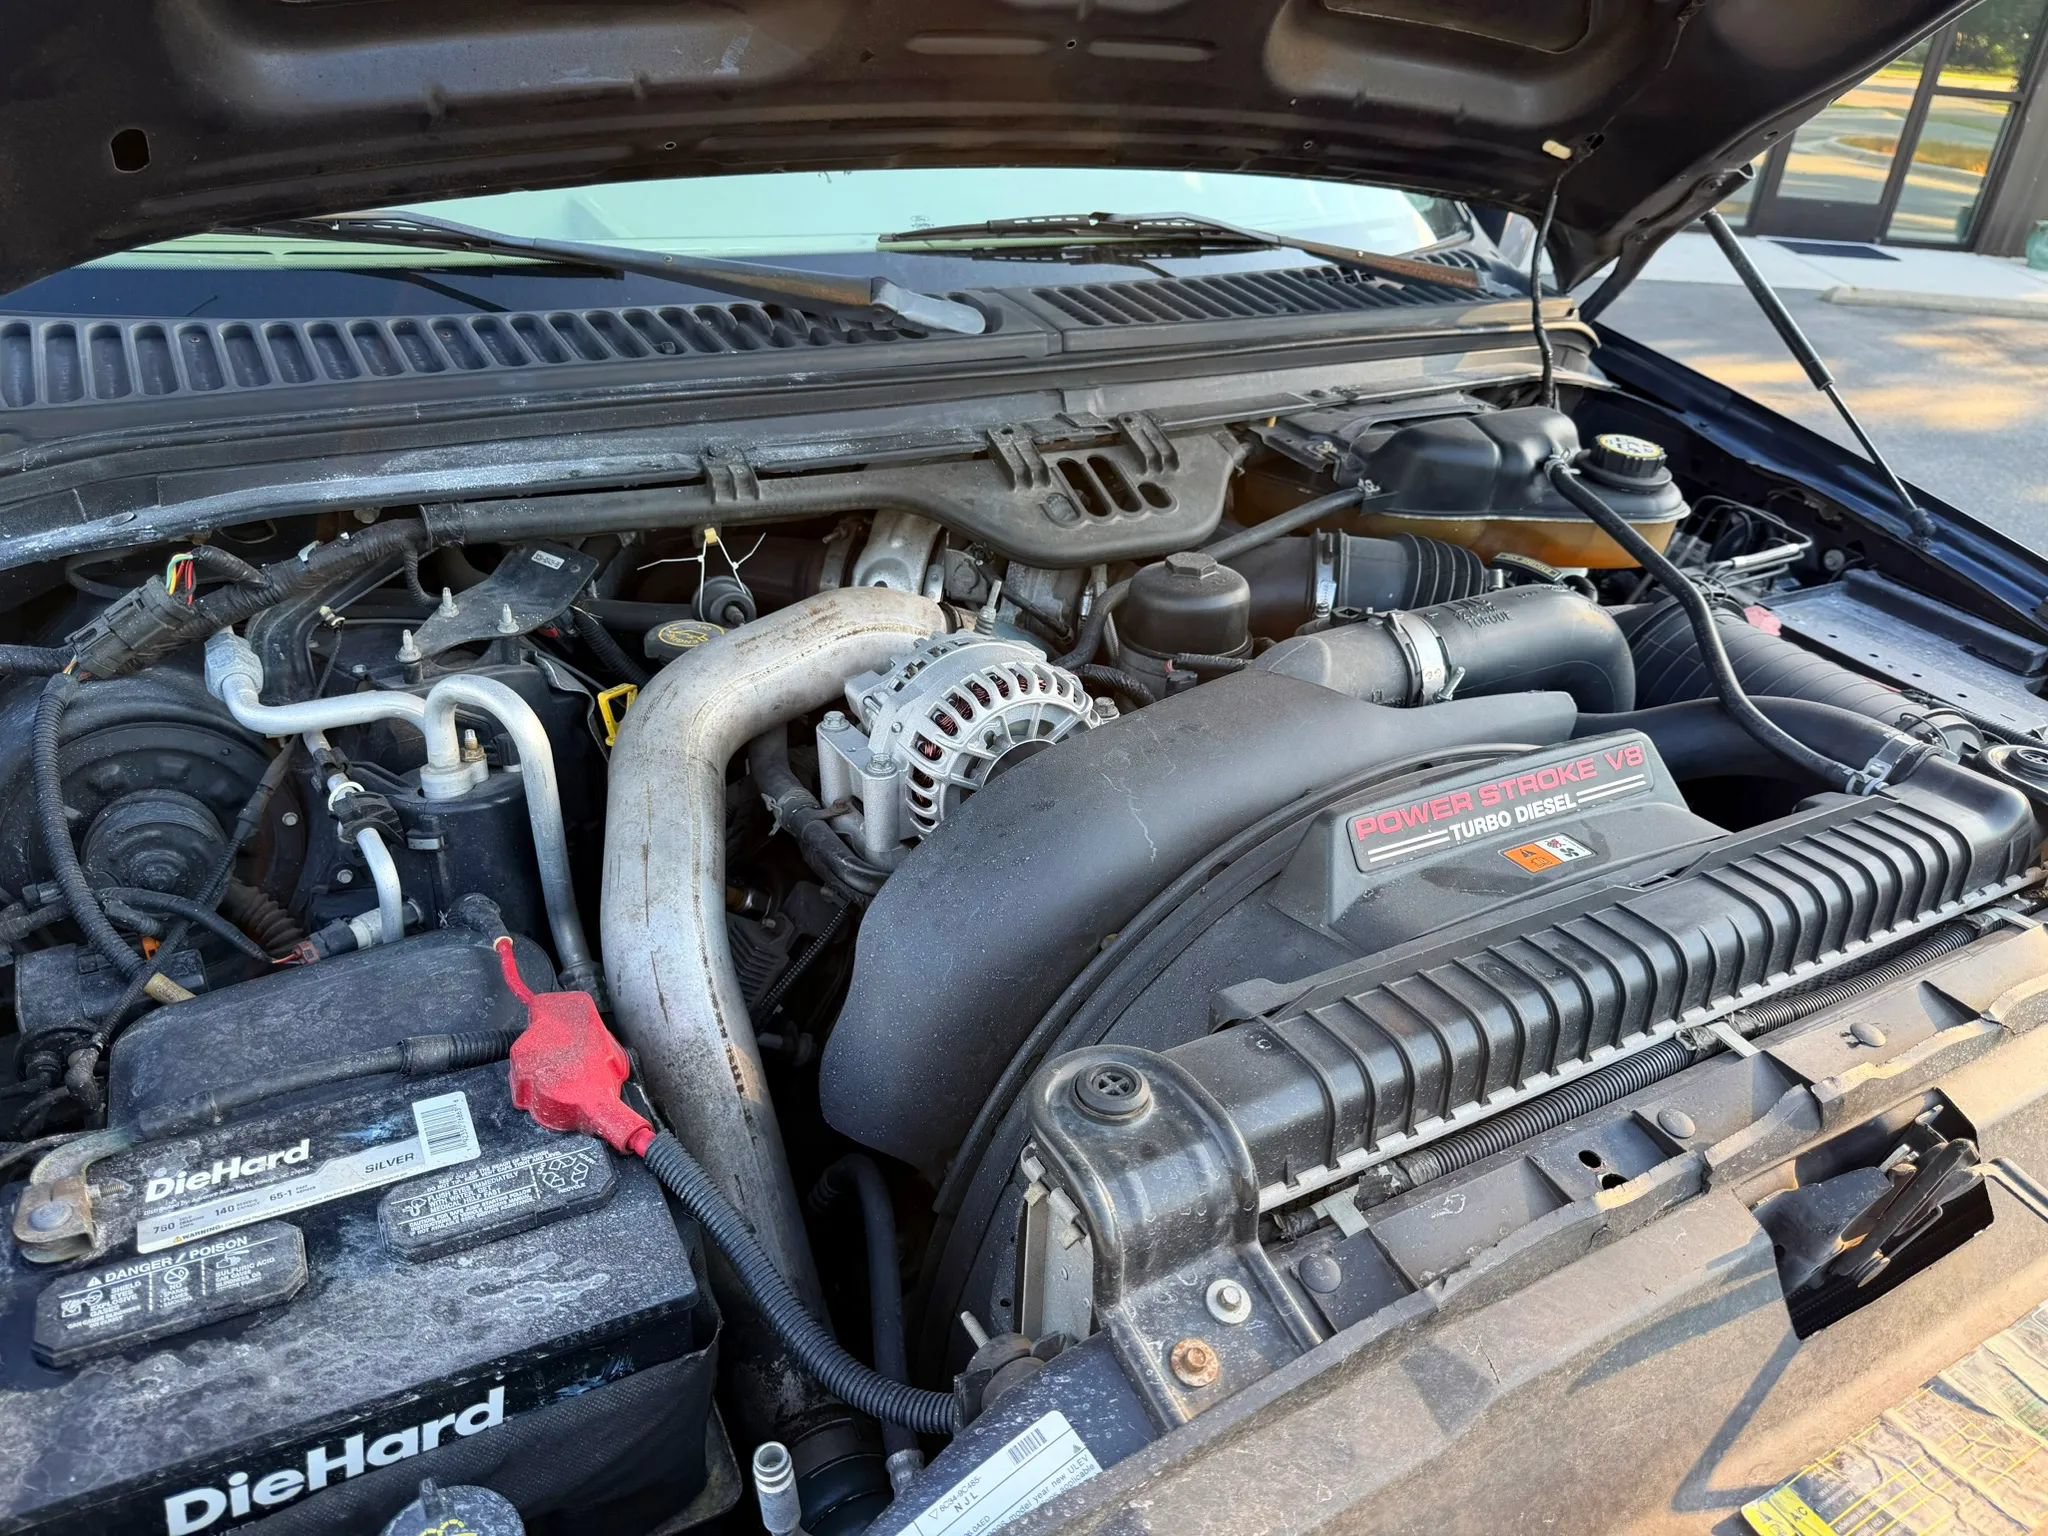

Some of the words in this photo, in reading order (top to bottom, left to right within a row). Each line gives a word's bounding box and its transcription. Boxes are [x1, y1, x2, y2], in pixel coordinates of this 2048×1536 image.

[1355, 791, 1473, 841] POWER
[1477, 758, 1597, 807] STROKE
[1604, 745, 1644, 771] V8
[1449, 810, 1511, 842] TURBO
[1515, 793, 1578, 823] DIESEL
[145, 1139, 310, 1204] DieHard
[365, 1152, 415, 1174] SILVER
[426, 1190, 452, 1203] FLUSH
[452, 1184, 470, 1195] EYES
[472, 1170, 519, 1189] IMMEDIATELY
[428, 1197, 448, 1208] WITH
[476, 1184, 492, 1194] GET
[429, 1199, 461, 1213] MEDICAL
[482, 1187, 502, 1198] FAST
[153, 1221, 175, 1234] 750
[215, 1203, 234, 1216] 140
[269, 1189, 291, 1202] 65-1
[105, 1257, 172, 1282] DANGER
[189, 1236, 248, 1259] POISON
[256, 1256, 274, 1266] ACID
[169, 1281, 181, 1290] NO
[165, 1386, 505, 1536] DieHard
[1008, 1500, 1033, 1521] model
[1033, 1486, 1052, 1503] year
[1051, 1473, 1067, 1487] new
[1067, 1454, 1089, 1473] ULEV
